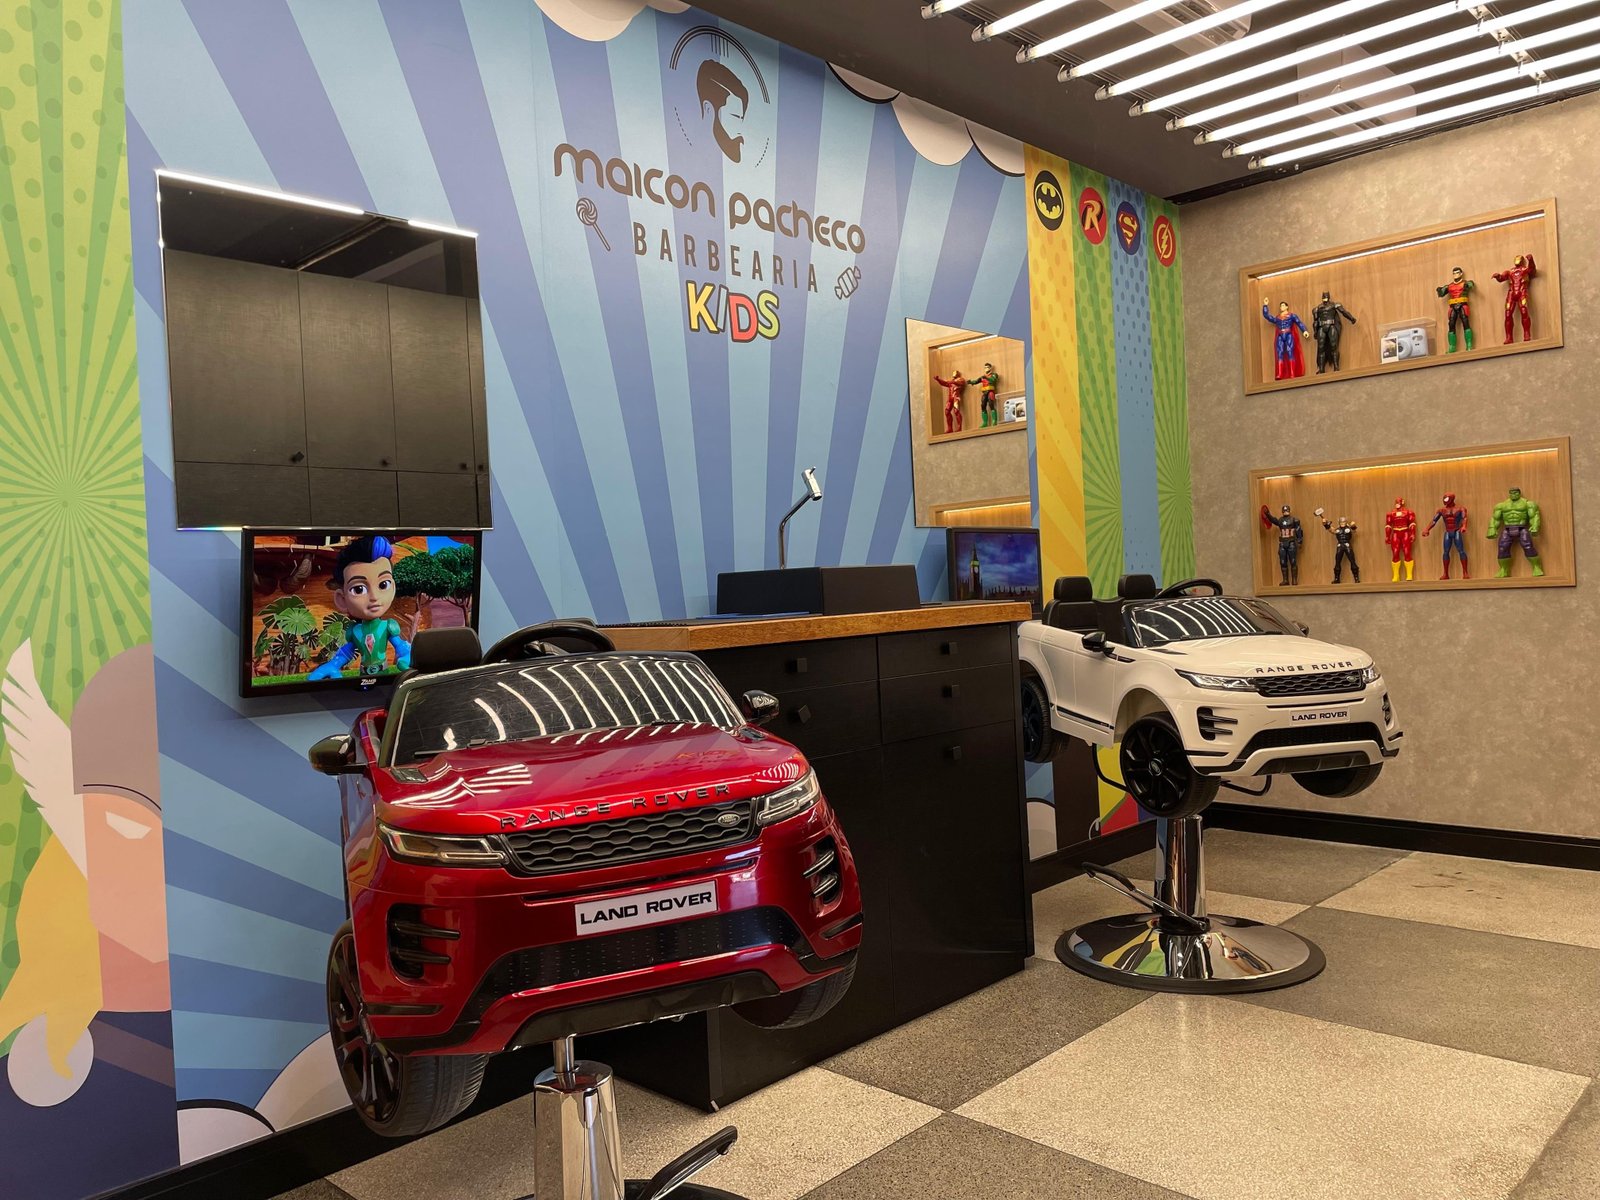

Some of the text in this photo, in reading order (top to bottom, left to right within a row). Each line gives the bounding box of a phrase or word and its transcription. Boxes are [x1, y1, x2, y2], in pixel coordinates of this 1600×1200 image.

[633, 222, 818, 293] BARBEARIA
[686, 280, 780, 343] KIDS
[1256, 661, 1353, 674] RANGE ROVER
[1292, 711, 1347, 721] LAND ROVER
[501, 784, 730, 828] RANGE ROVER
[580, 891, 713, 925] LAND ROVER
